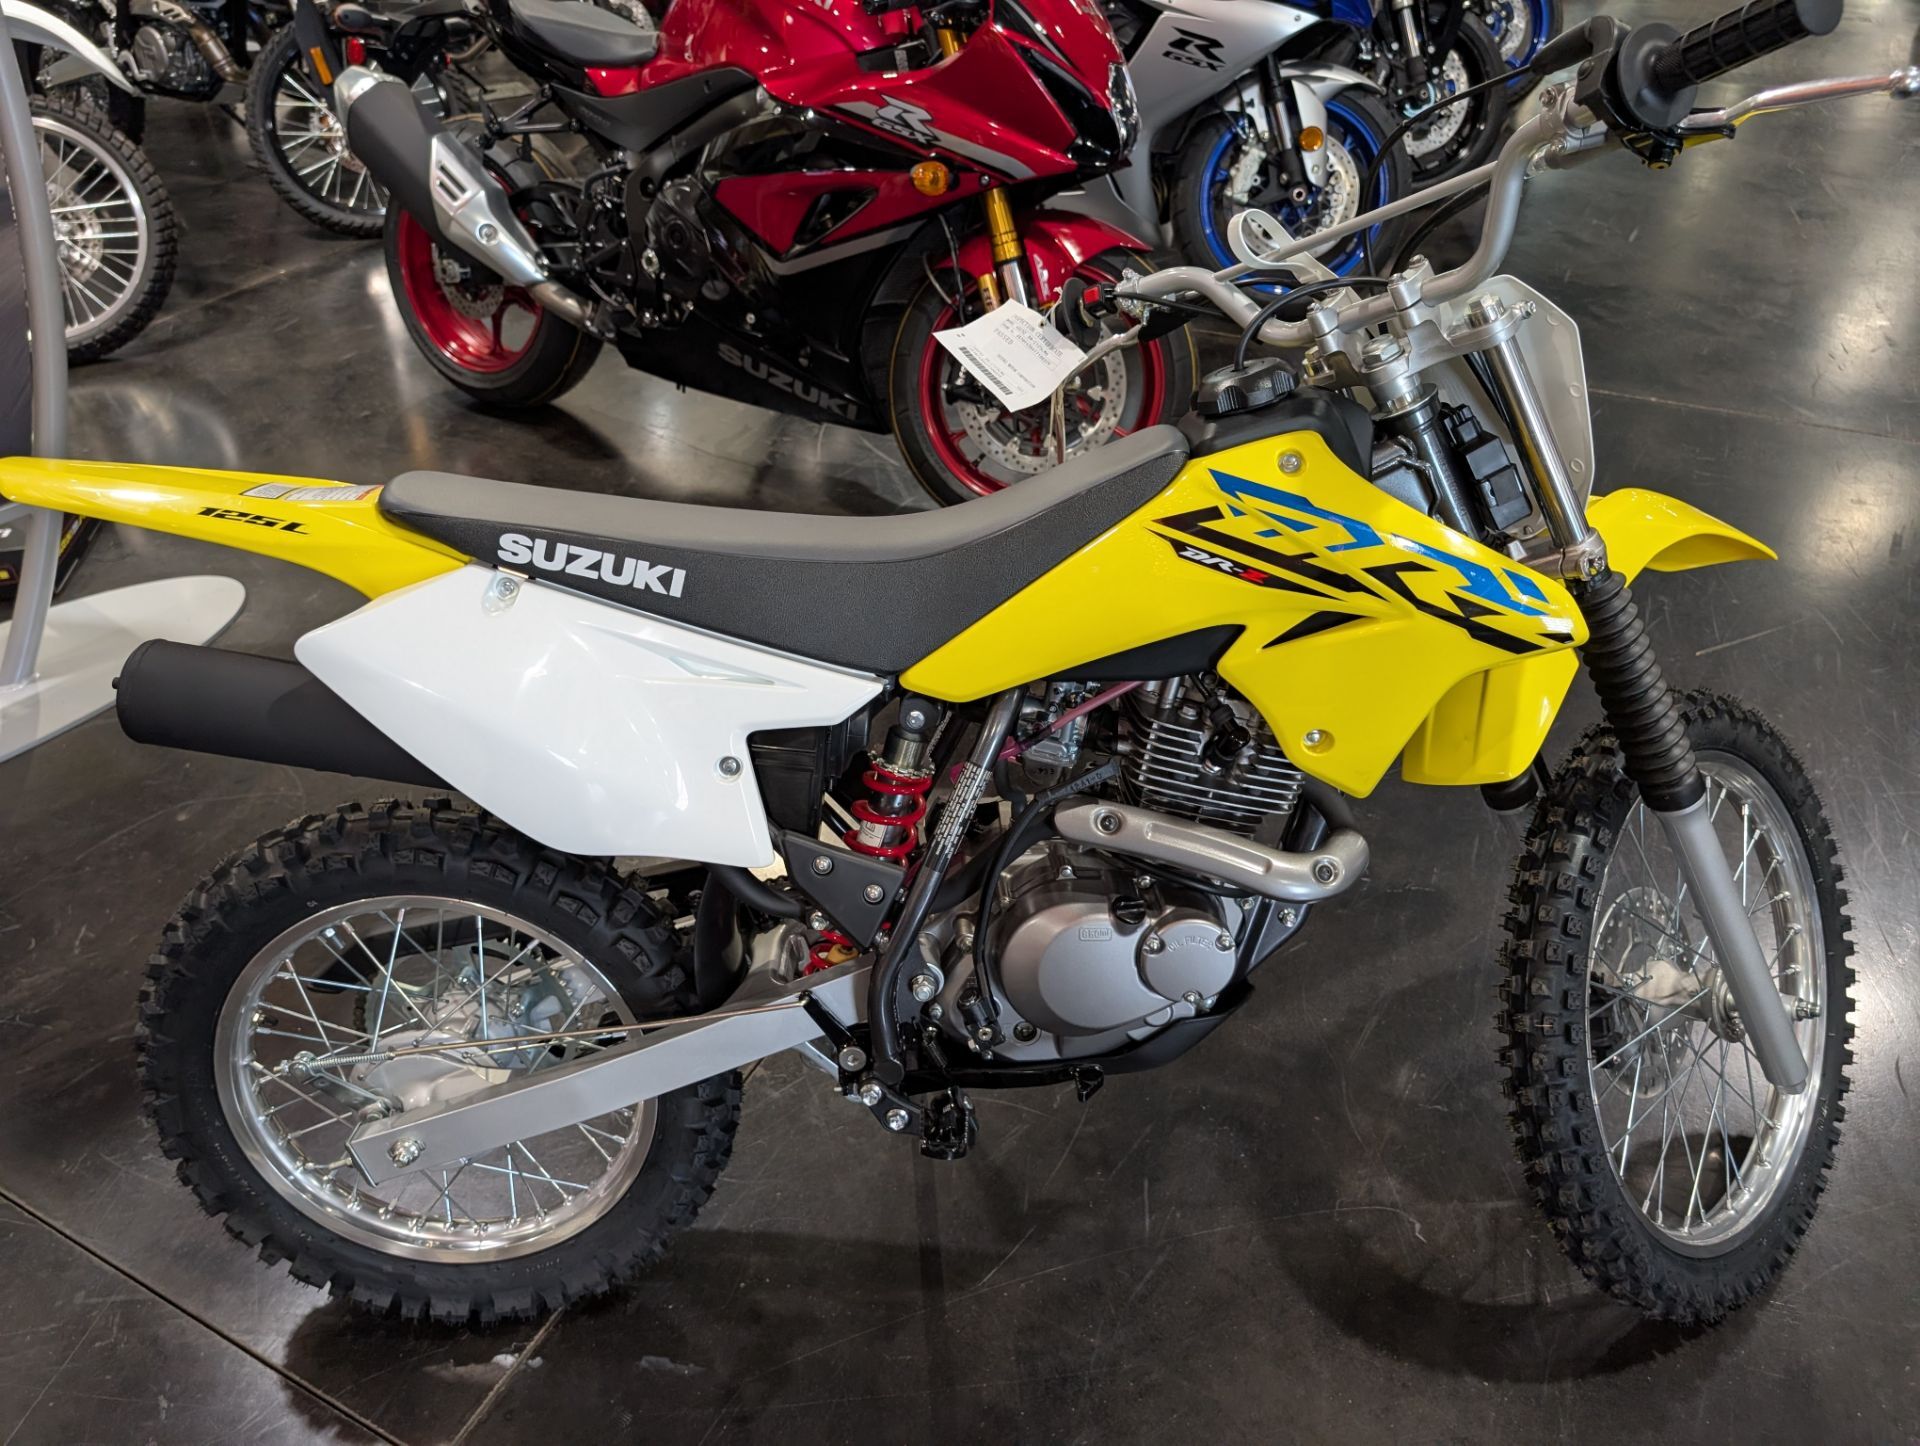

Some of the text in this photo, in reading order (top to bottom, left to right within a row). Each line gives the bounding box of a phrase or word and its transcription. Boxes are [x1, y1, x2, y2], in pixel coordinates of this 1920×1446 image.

[717, 342, 858, 421] SUZUKI
[197, 506, 310, 535] 125L
[497, 532, 687, 598] SUZUKI
[1179, 546, 1269, 584] DR-Z
